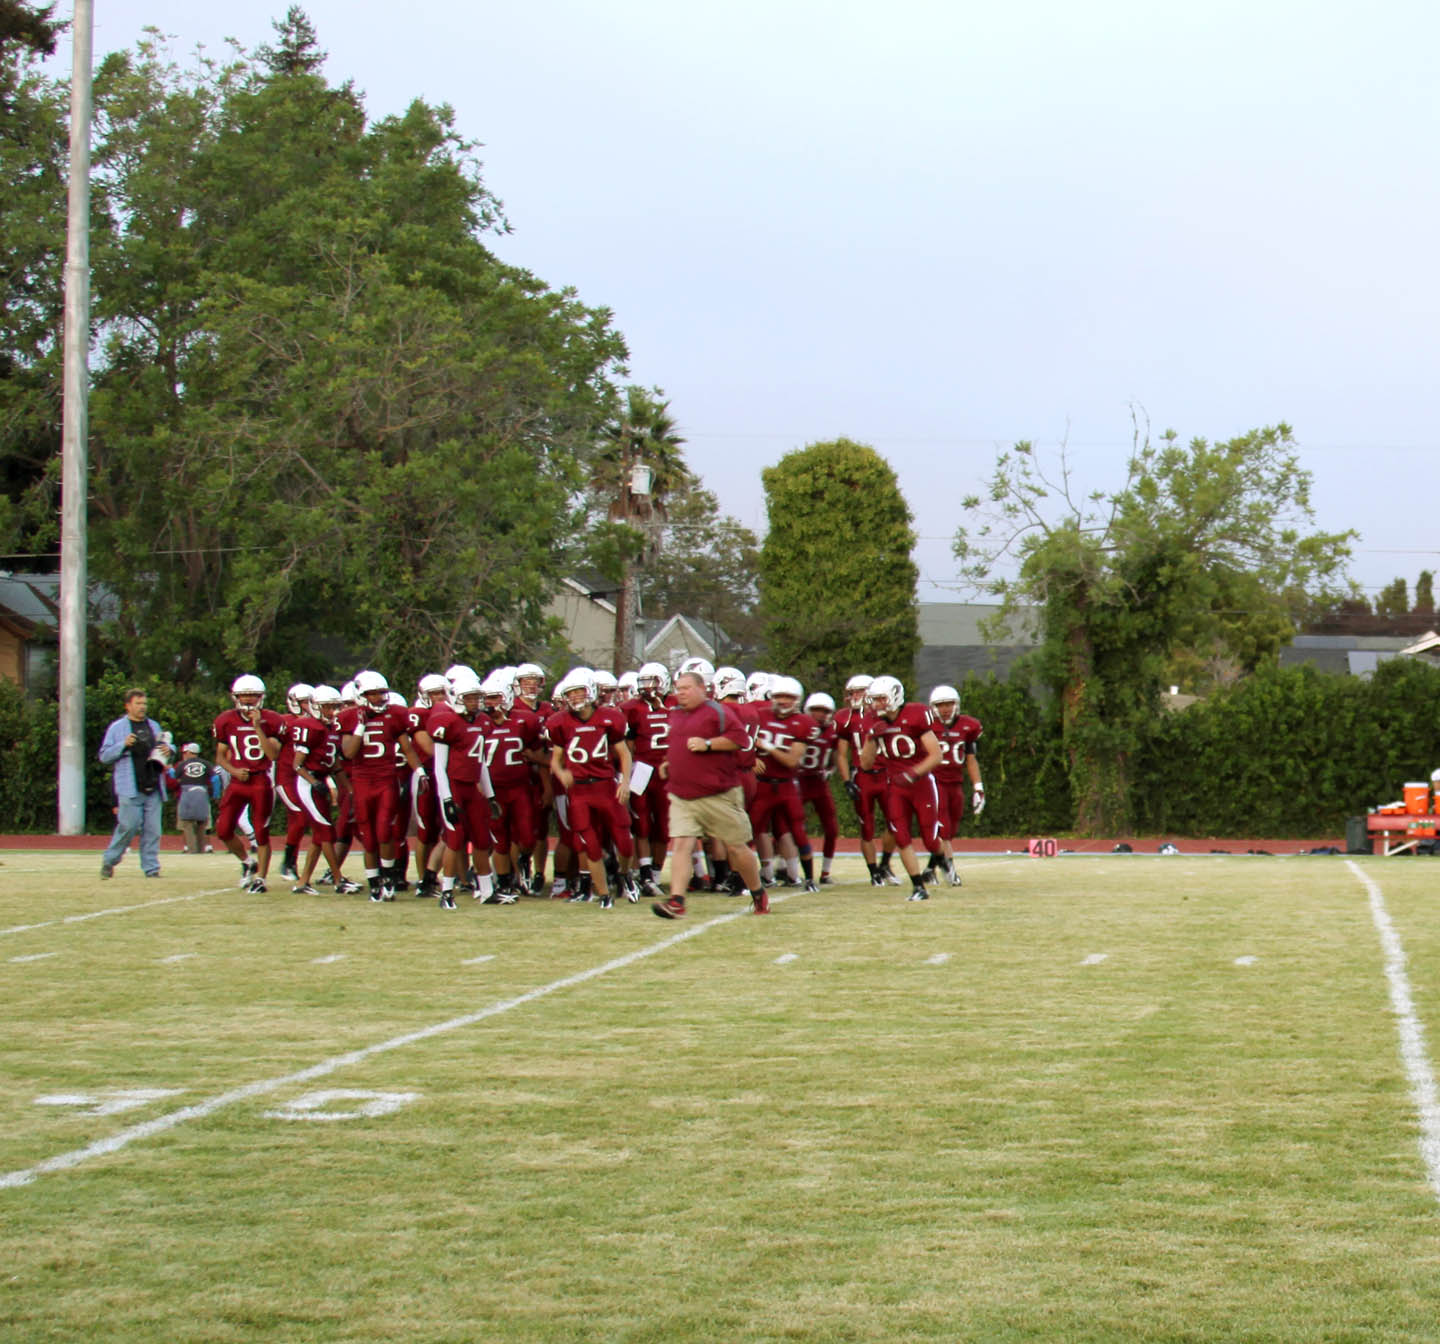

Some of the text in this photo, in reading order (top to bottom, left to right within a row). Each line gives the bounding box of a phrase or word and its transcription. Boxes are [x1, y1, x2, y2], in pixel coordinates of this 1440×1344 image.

[230, 732, 265, 761] 18
[363, 730, 386, 759] 5
[433, 726, 445, 739] 4
[485, 737, 524, 767] 72
[567, 733, 609, 763] 64
[1032, 840, 1055, 857] 40
